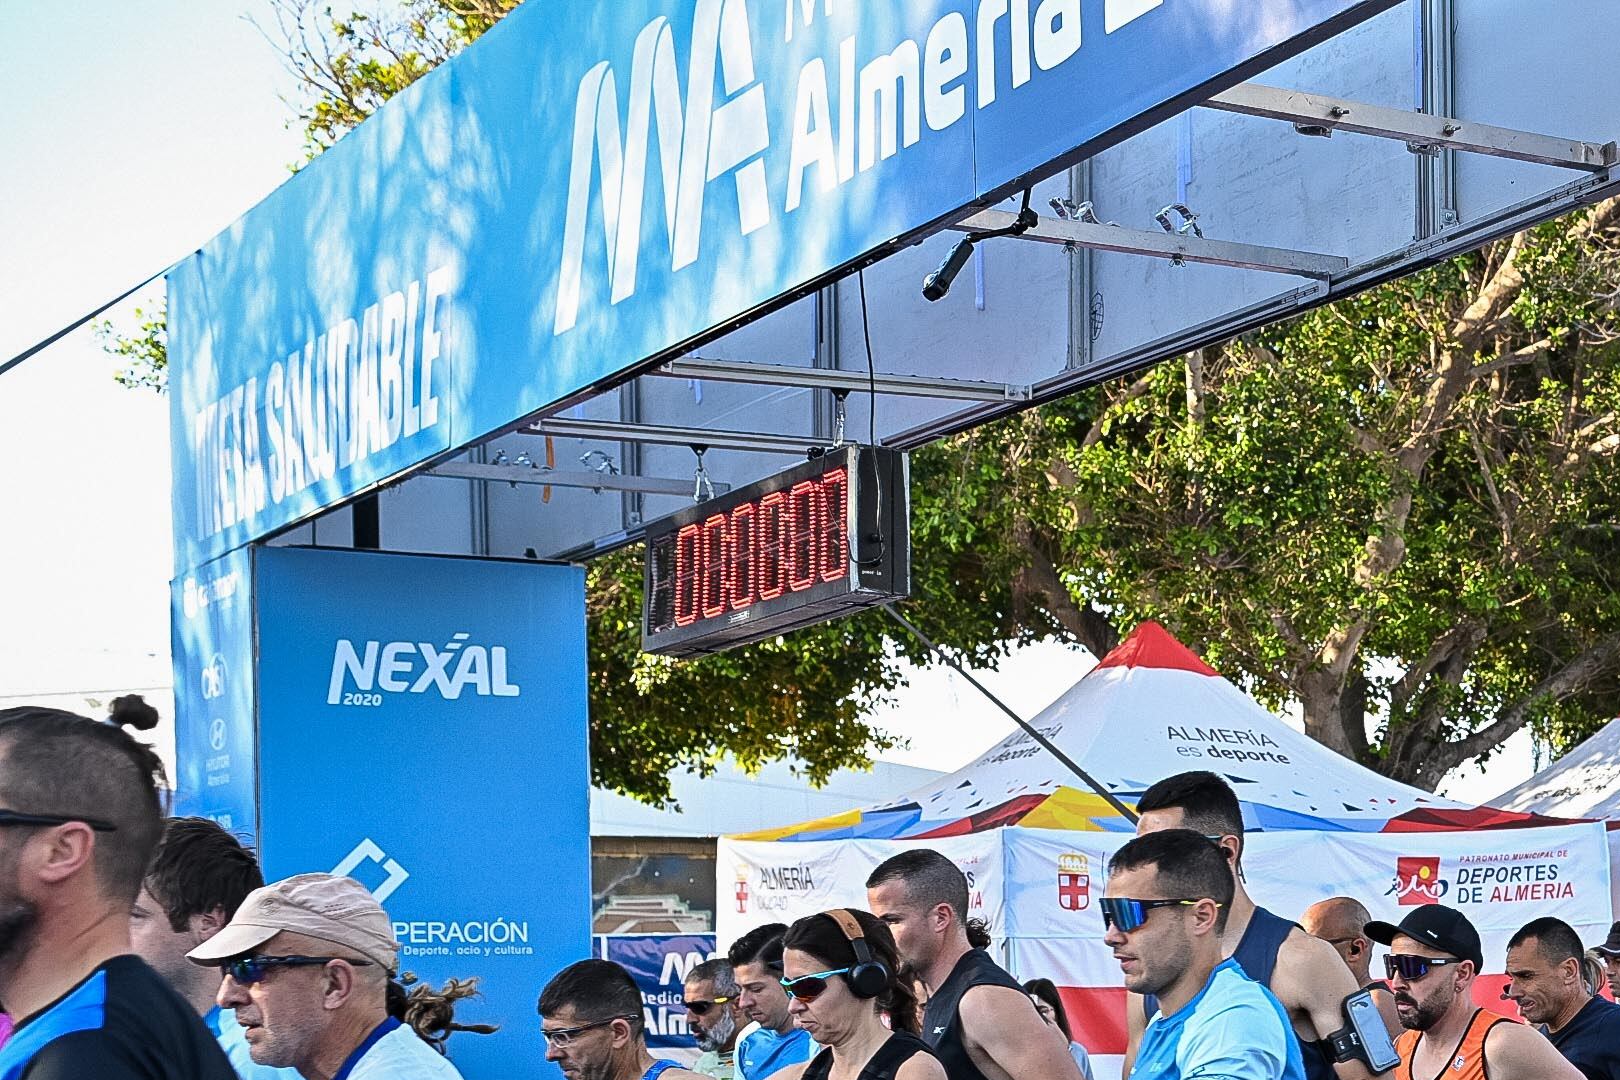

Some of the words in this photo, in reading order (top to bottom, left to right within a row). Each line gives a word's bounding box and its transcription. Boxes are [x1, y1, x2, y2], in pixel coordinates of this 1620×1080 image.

[264, 265, 450, 505] SALUDABLE
[343, 692, 383, 707] 2020
[1167, 725, 1280, 749] ALMERÍA
[1176, 745, 1202, 760] es
[1206, 745, 1292, 766] deporte
[1459, 855, 1511, 863] PATRONATO
[1512, 851, 1554, 861] MUNICIPAL
[1557, 849, 1569, 858] DE
[1456, 864, 1559, 885] DEPORTES
[1457, 887, 1483, 904] DE
[1490, 882, 1574, 903] ALMERIA
[393, 917, 528, 944] PERACIÓN
[403, 945, 453, 956] Deporte,
[456, 946, 480, 956] ocio
[484, 947, 491, 957] y
[494, 945, 534, 956] cultura
